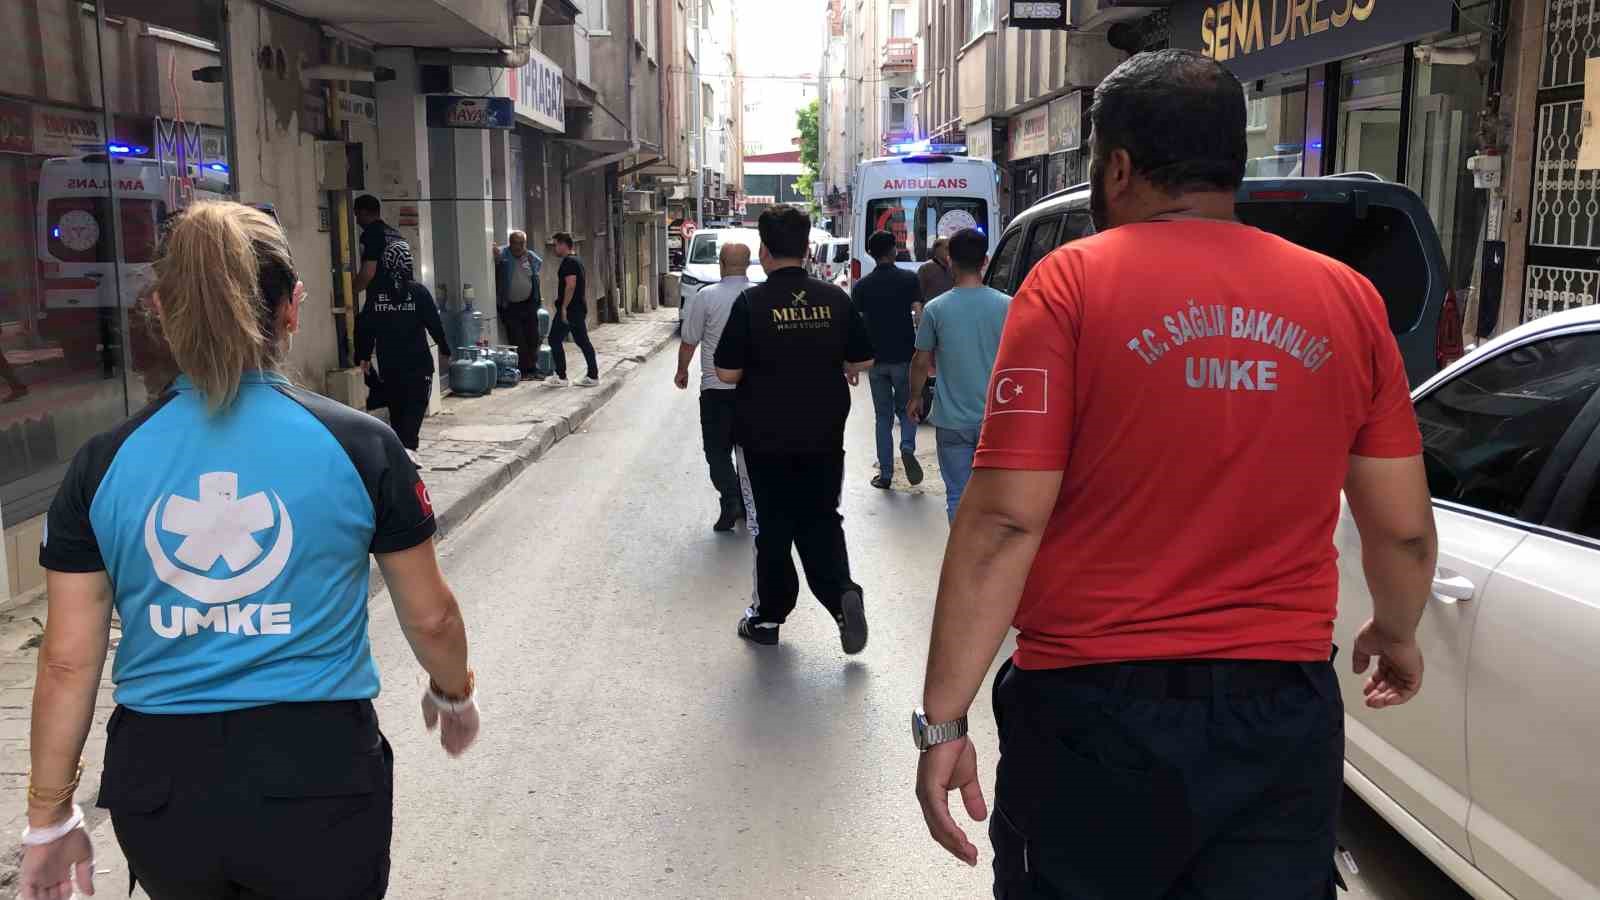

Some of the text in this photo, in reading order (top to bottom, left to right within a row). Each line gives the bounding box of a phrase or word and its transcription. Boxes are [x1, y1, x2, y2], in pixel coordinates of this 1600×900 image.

[1201, 0, 1264, 61] SENA
[884, 179, 967, 190] AMBULANS
[1231, 306, 1332, 373] BAKANLIĞI
[1185, 357, 1277, 391] UMKE
[149, 603, 291, 639] UMKE
